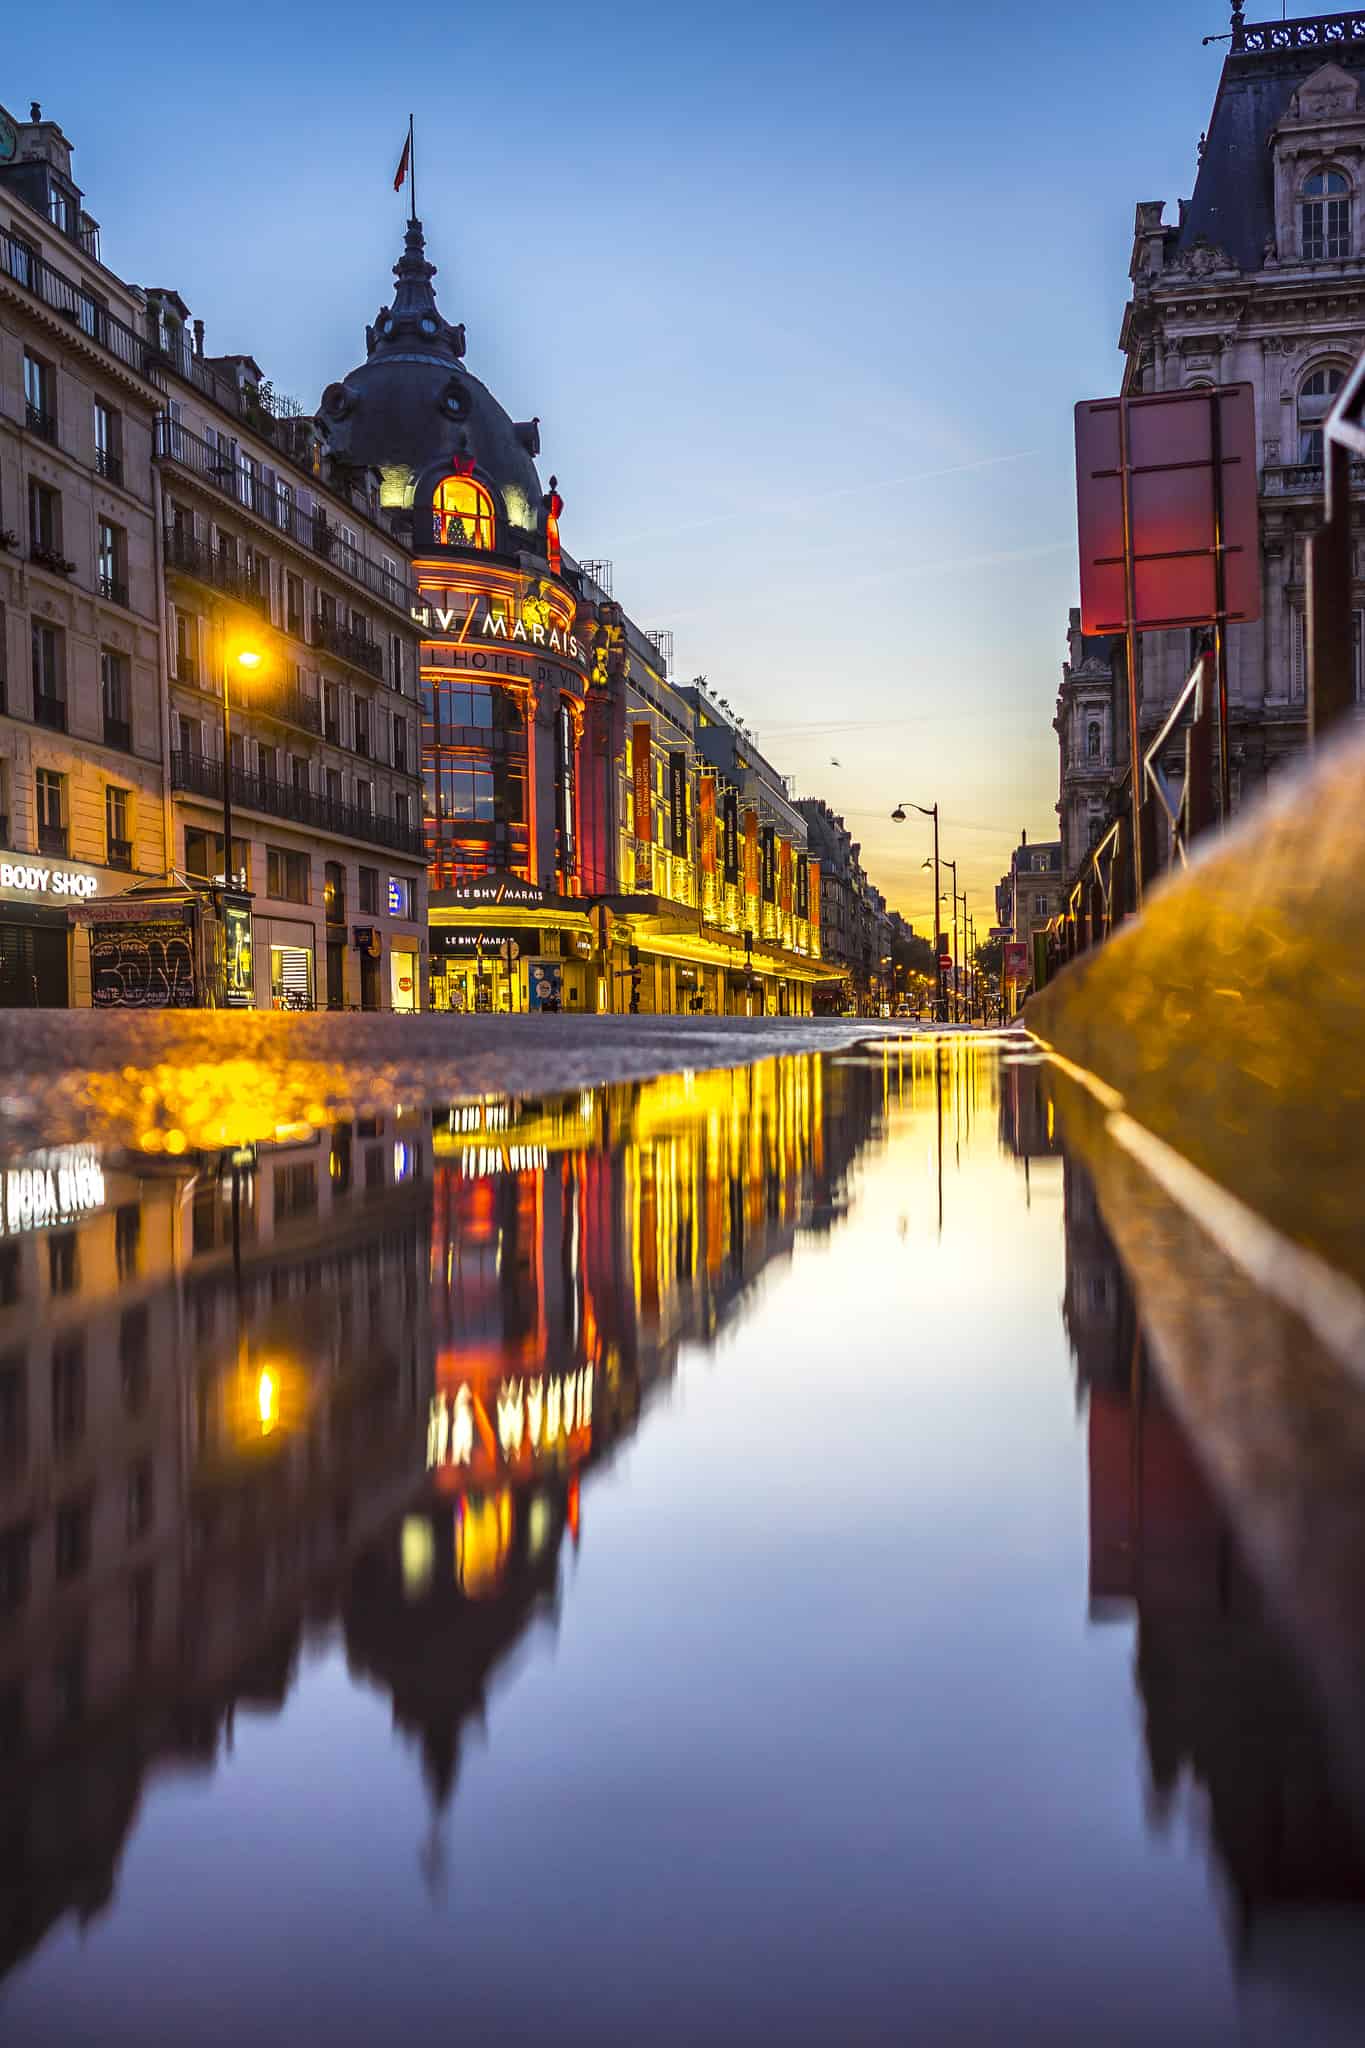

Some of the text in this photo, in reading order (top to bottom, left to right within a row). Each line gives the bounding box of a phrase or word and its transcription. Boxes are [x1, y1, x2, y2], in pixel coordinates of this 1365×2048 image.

[482, 612, 578, 657] MARAIS
[0, 863, 98, 897] BODY SHOP
[456, 889, 471, 898] LE
[445, 936, 456, 945] LE
